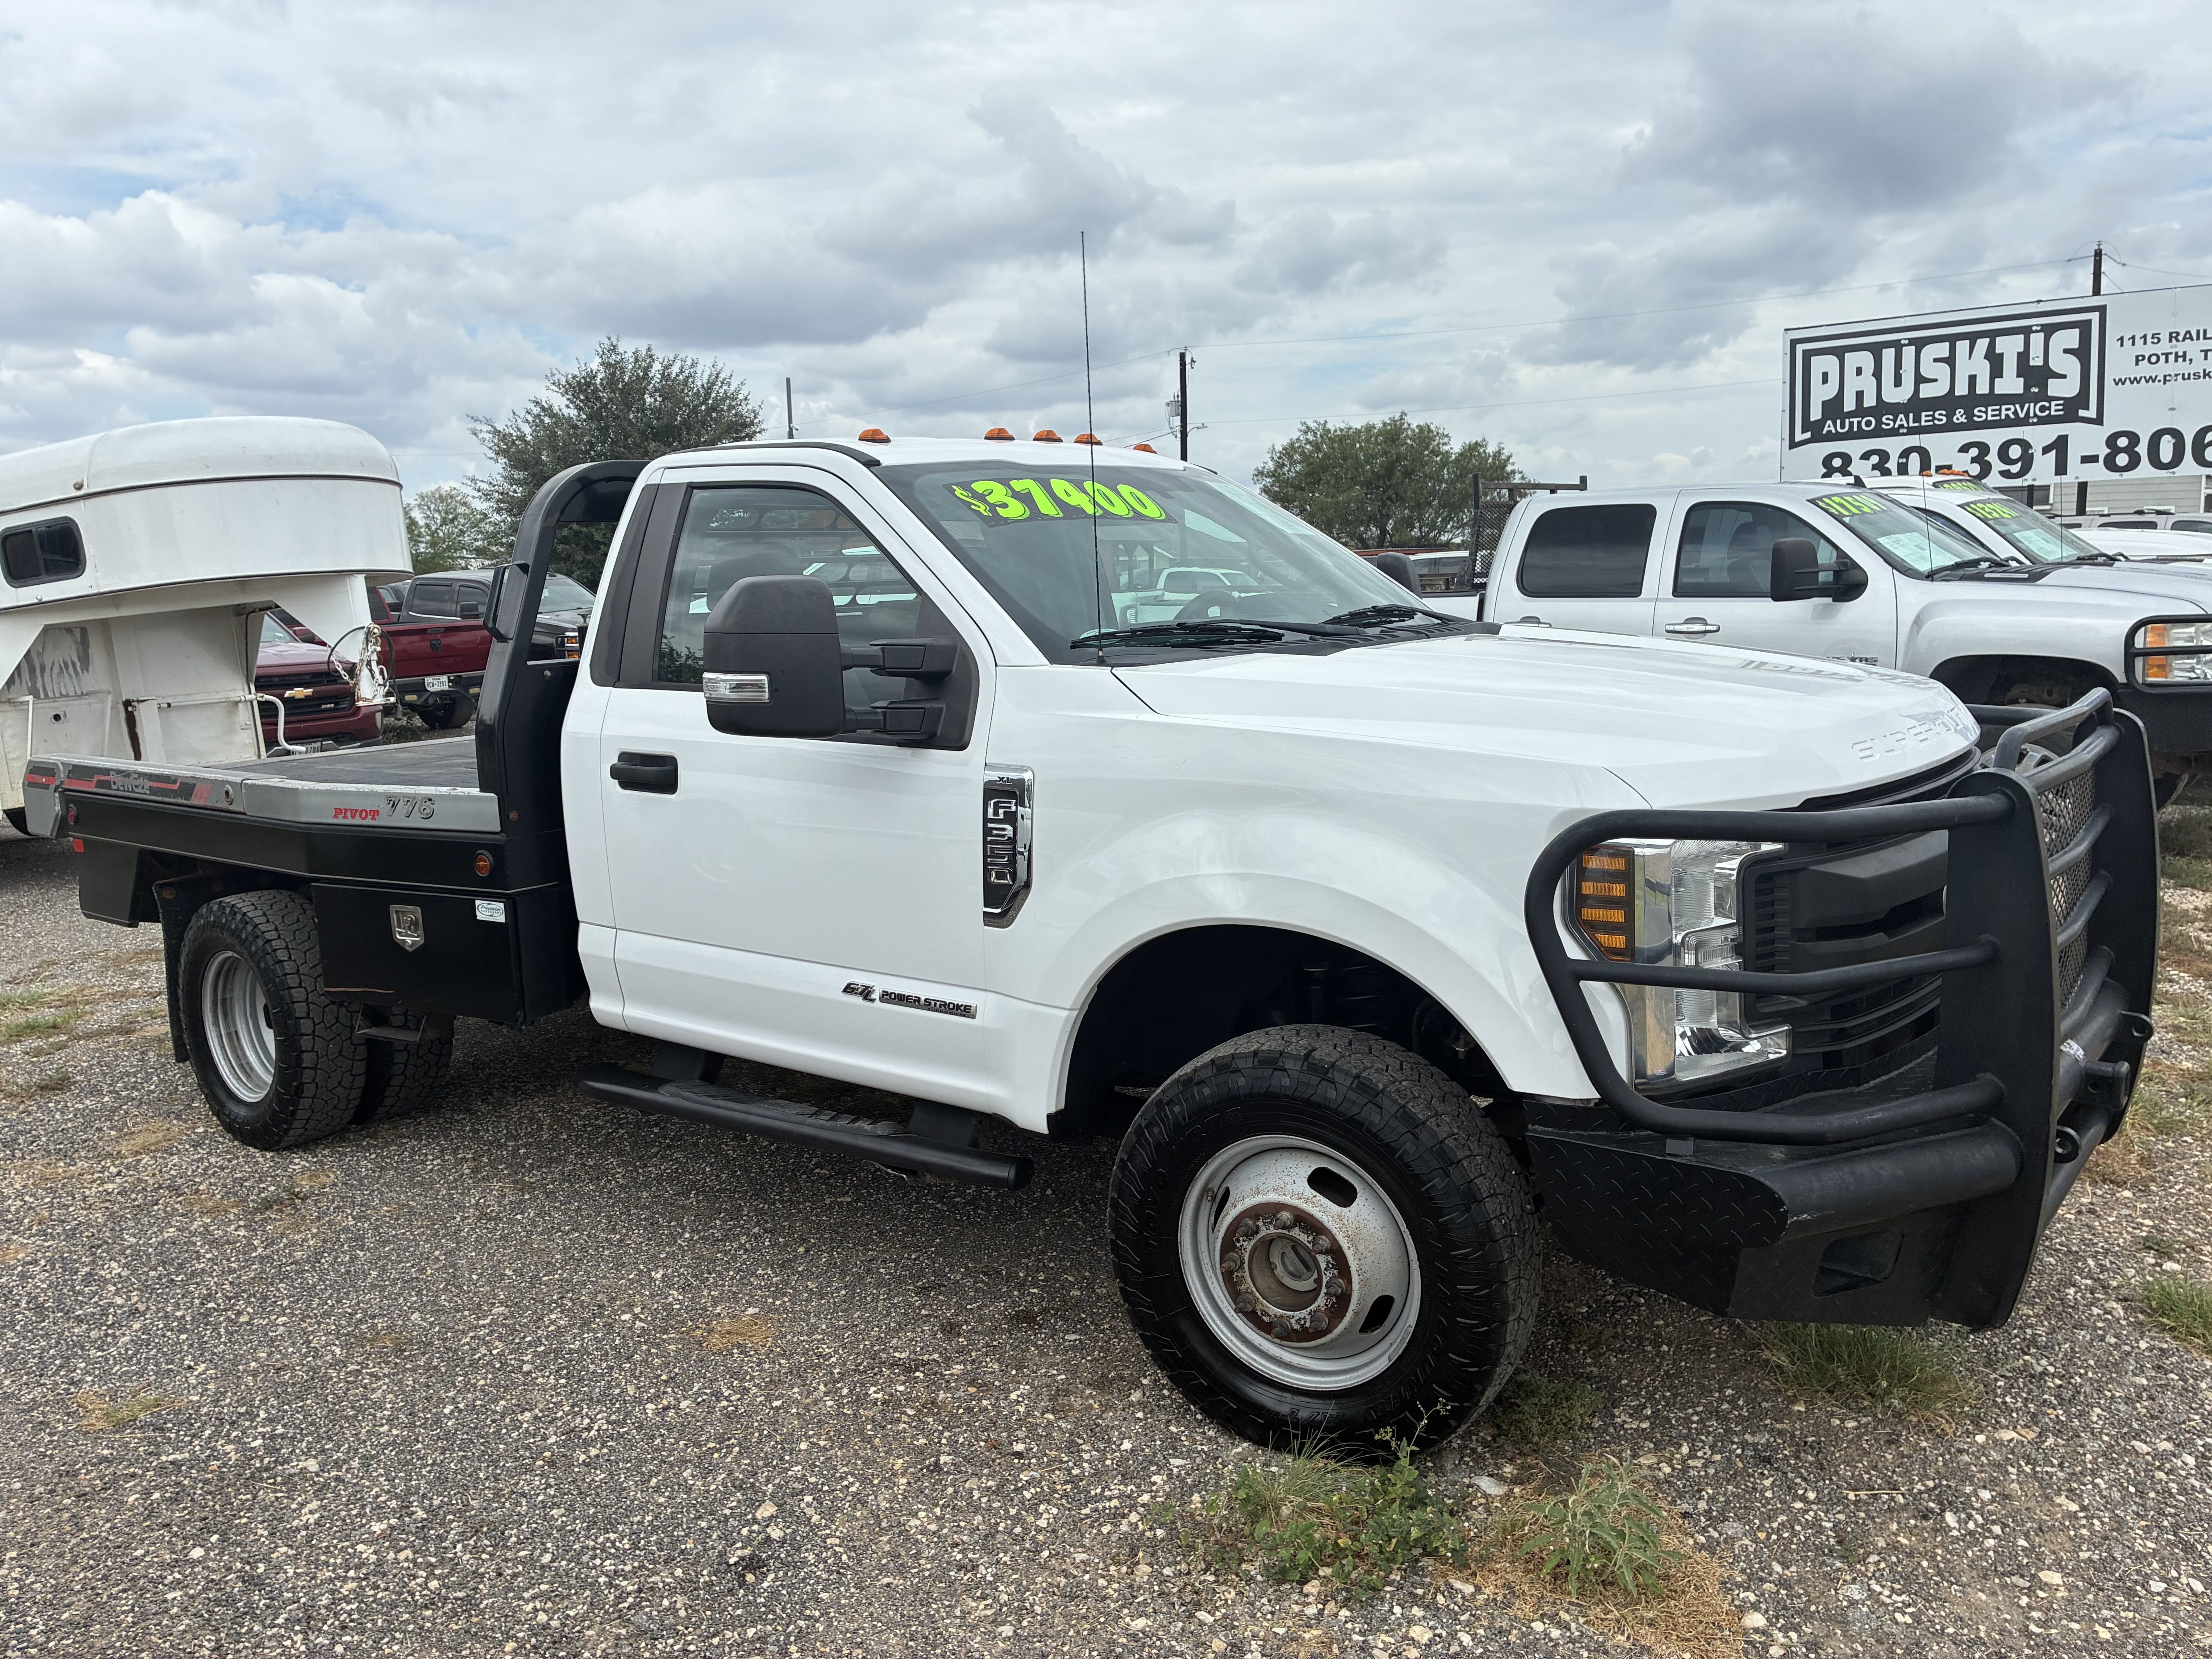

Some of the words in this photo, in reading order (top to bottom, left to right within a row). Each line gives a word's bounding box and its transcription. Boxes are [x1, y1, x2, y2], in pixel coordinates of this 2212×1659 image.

[2116, 332, 2161, 347] 1115
[2168, 328, 2212, 343] RAIL
[2135, 350, 2193, 366] POTH,
[1810, 328, 2081, 421] PRUSKI'S
[2112, 368, 2212, 386] www.prusk
[1822, 416, 1875, 434] AUTO
[1881, 410, 1947, 429] SALES
[1953, 408, 1968, 424] &
[1973, 400, 2064, 421] SERVICE
[951, 478, 1166, 520] $37400
[996, 776, 1013, 785] XL
[332, 807, 380, 821] PIVOT
[386, 795, 435, 820] 776
[988, 799, 1017, 885] F350
[841, 981, 877, 1003] 6.7L
[881, 990, 921, 1005] POWER
[924, 998, 972, 1014] STROKE
